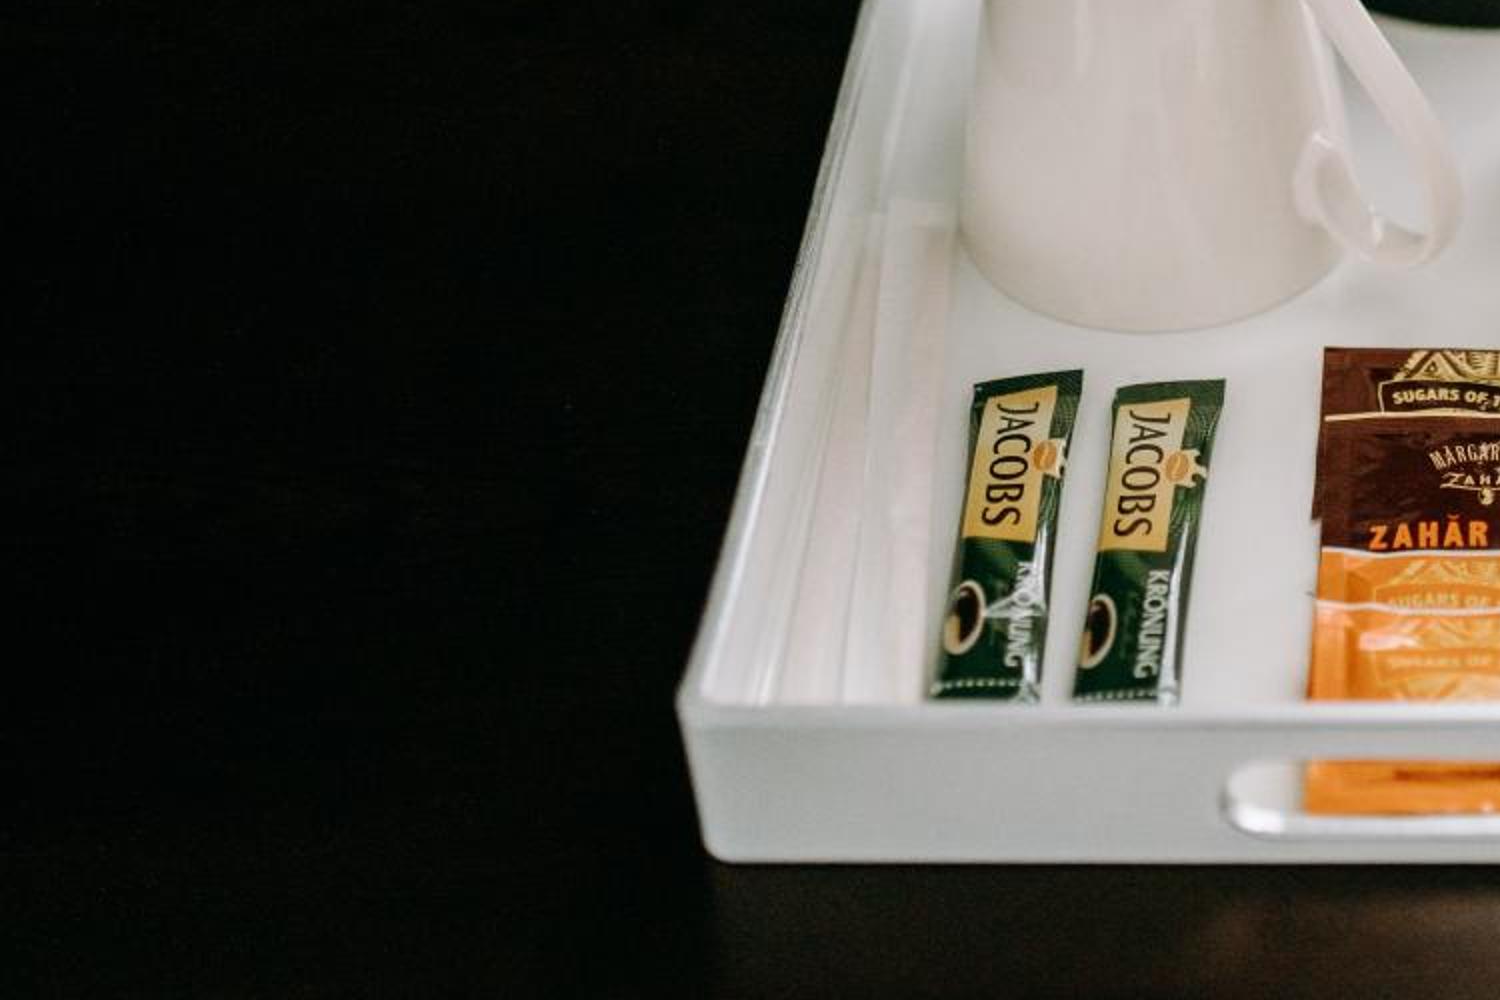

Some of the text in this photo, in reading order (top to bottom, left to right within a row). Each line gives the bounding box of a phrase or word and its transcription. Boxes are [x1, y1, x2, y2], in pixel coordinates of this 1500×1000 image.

[1392, 387, 1460, 405] SUGARS
[1464, 389, 1489, 404] OF
[981, 402, 1040, 527] JACOBS
[1113, 410, 1172, 537] JACOBS
[1369, 513, 1489, 549] ZAHĂR
